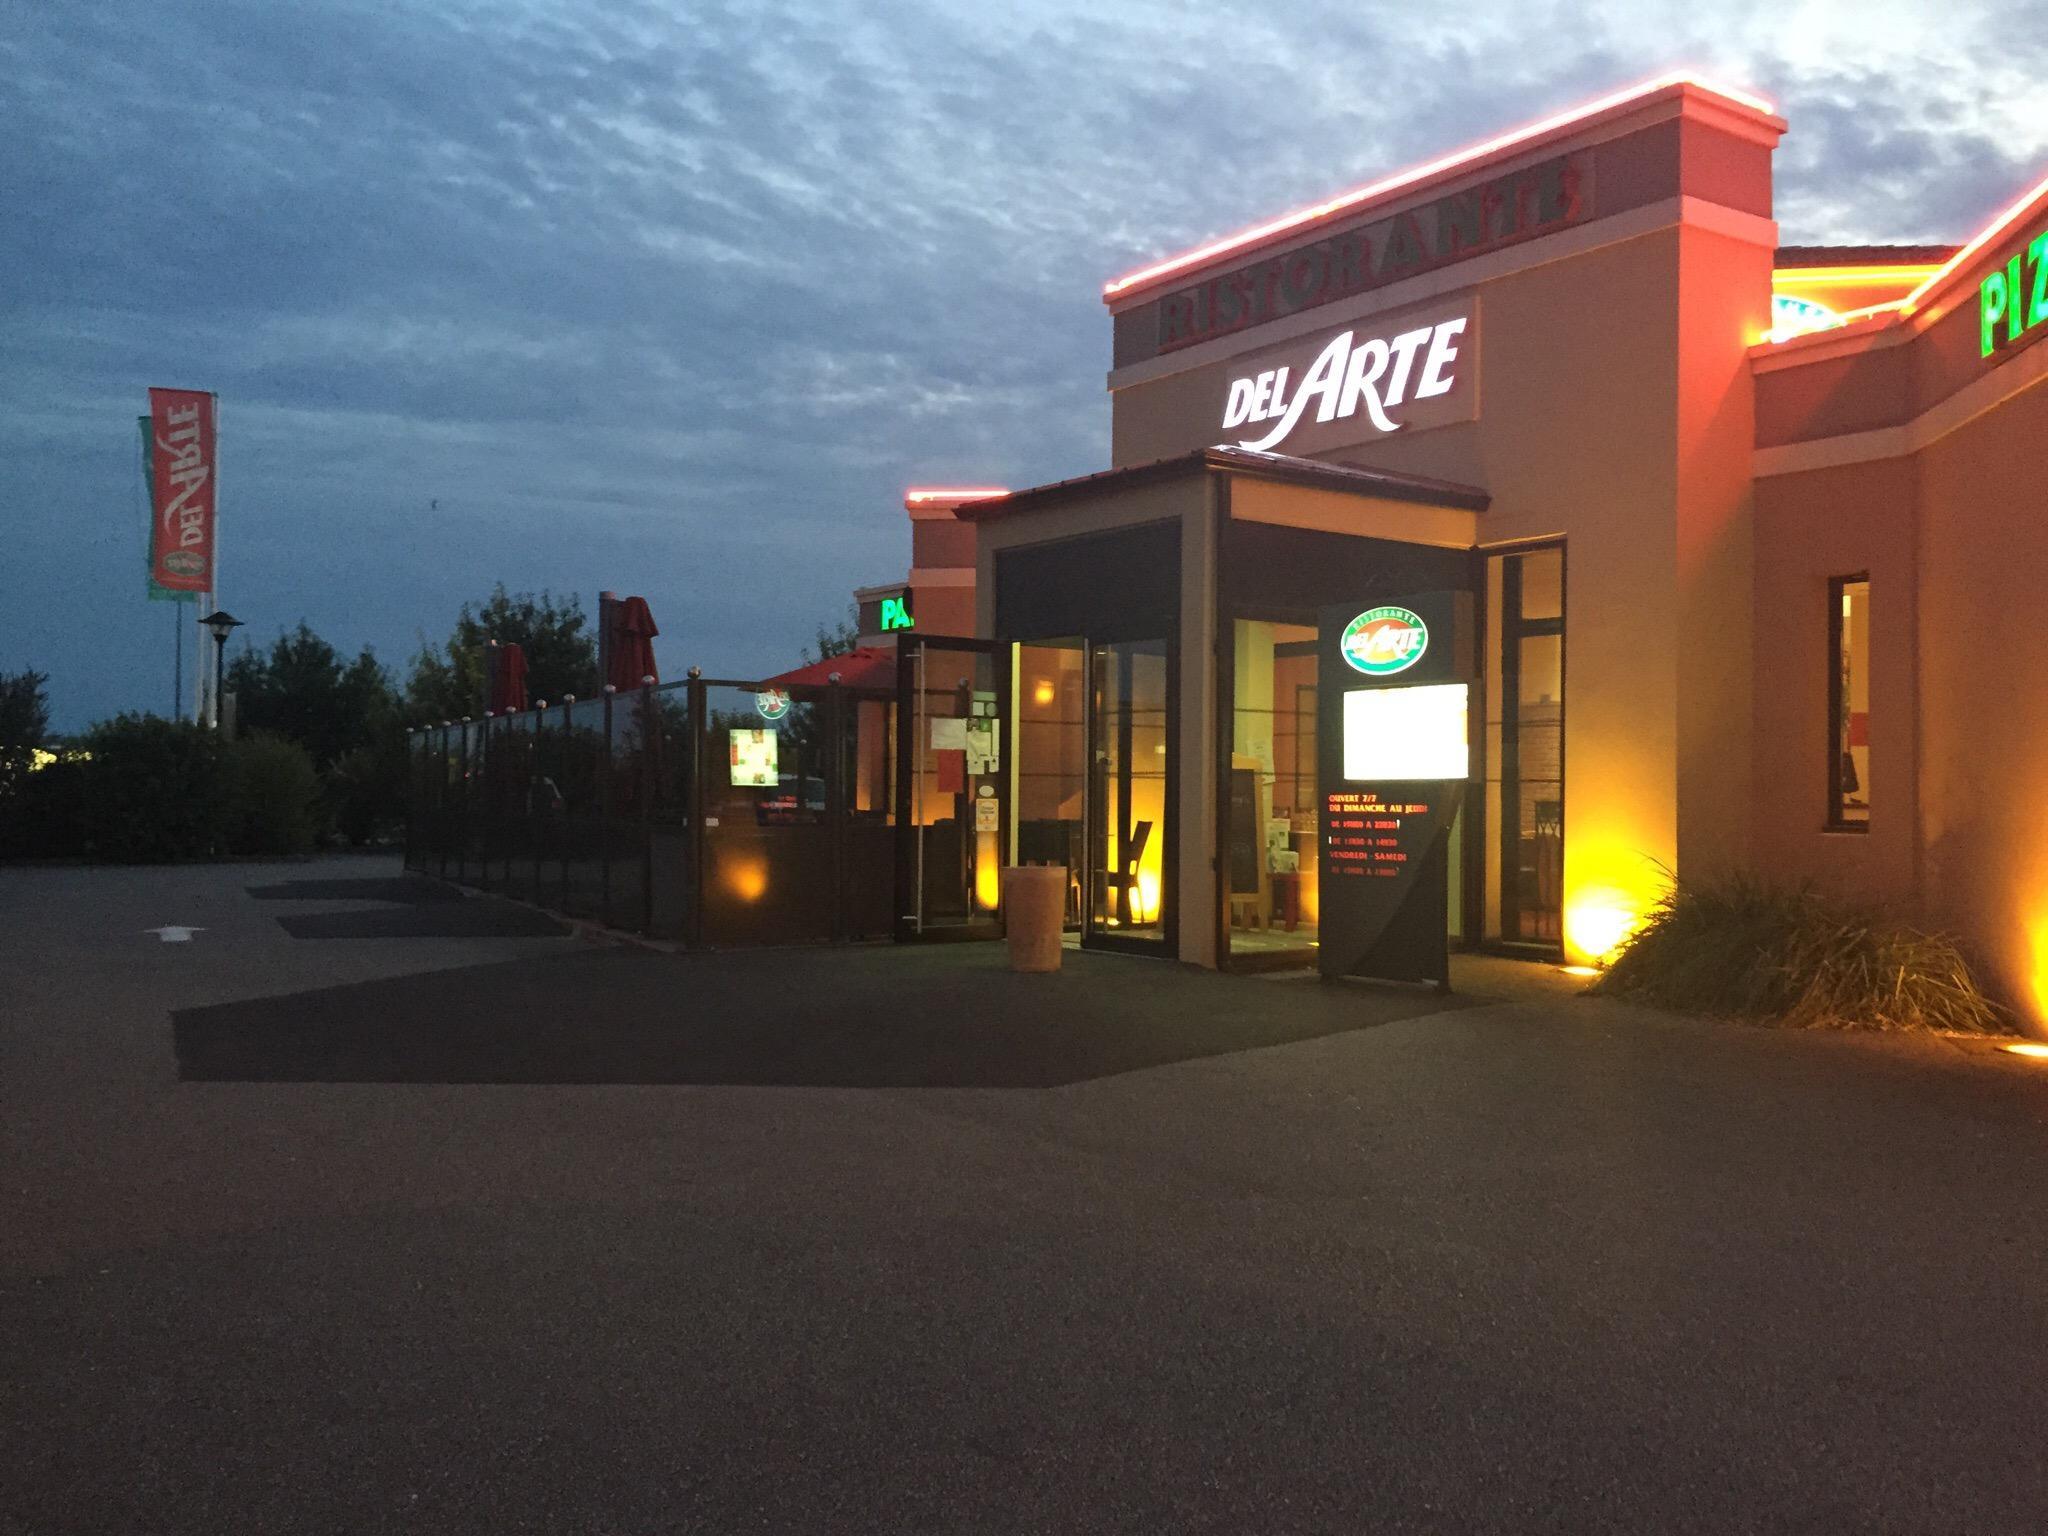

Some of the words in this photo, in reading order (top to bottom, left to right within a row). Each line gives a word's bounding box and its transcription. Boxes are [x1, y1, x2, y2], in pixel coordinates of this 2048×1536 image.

[1160, 155, 1582, 347] RISTORANTE
[1222, 367, 1290, 428] DEL
[1238, 317, 1467, 451] ARTE
[881, 597, 915, 630] PA
[1328, 794, 1359, 803] OUVERT
[1343, 804, 1386, 813] DIMANCHE
